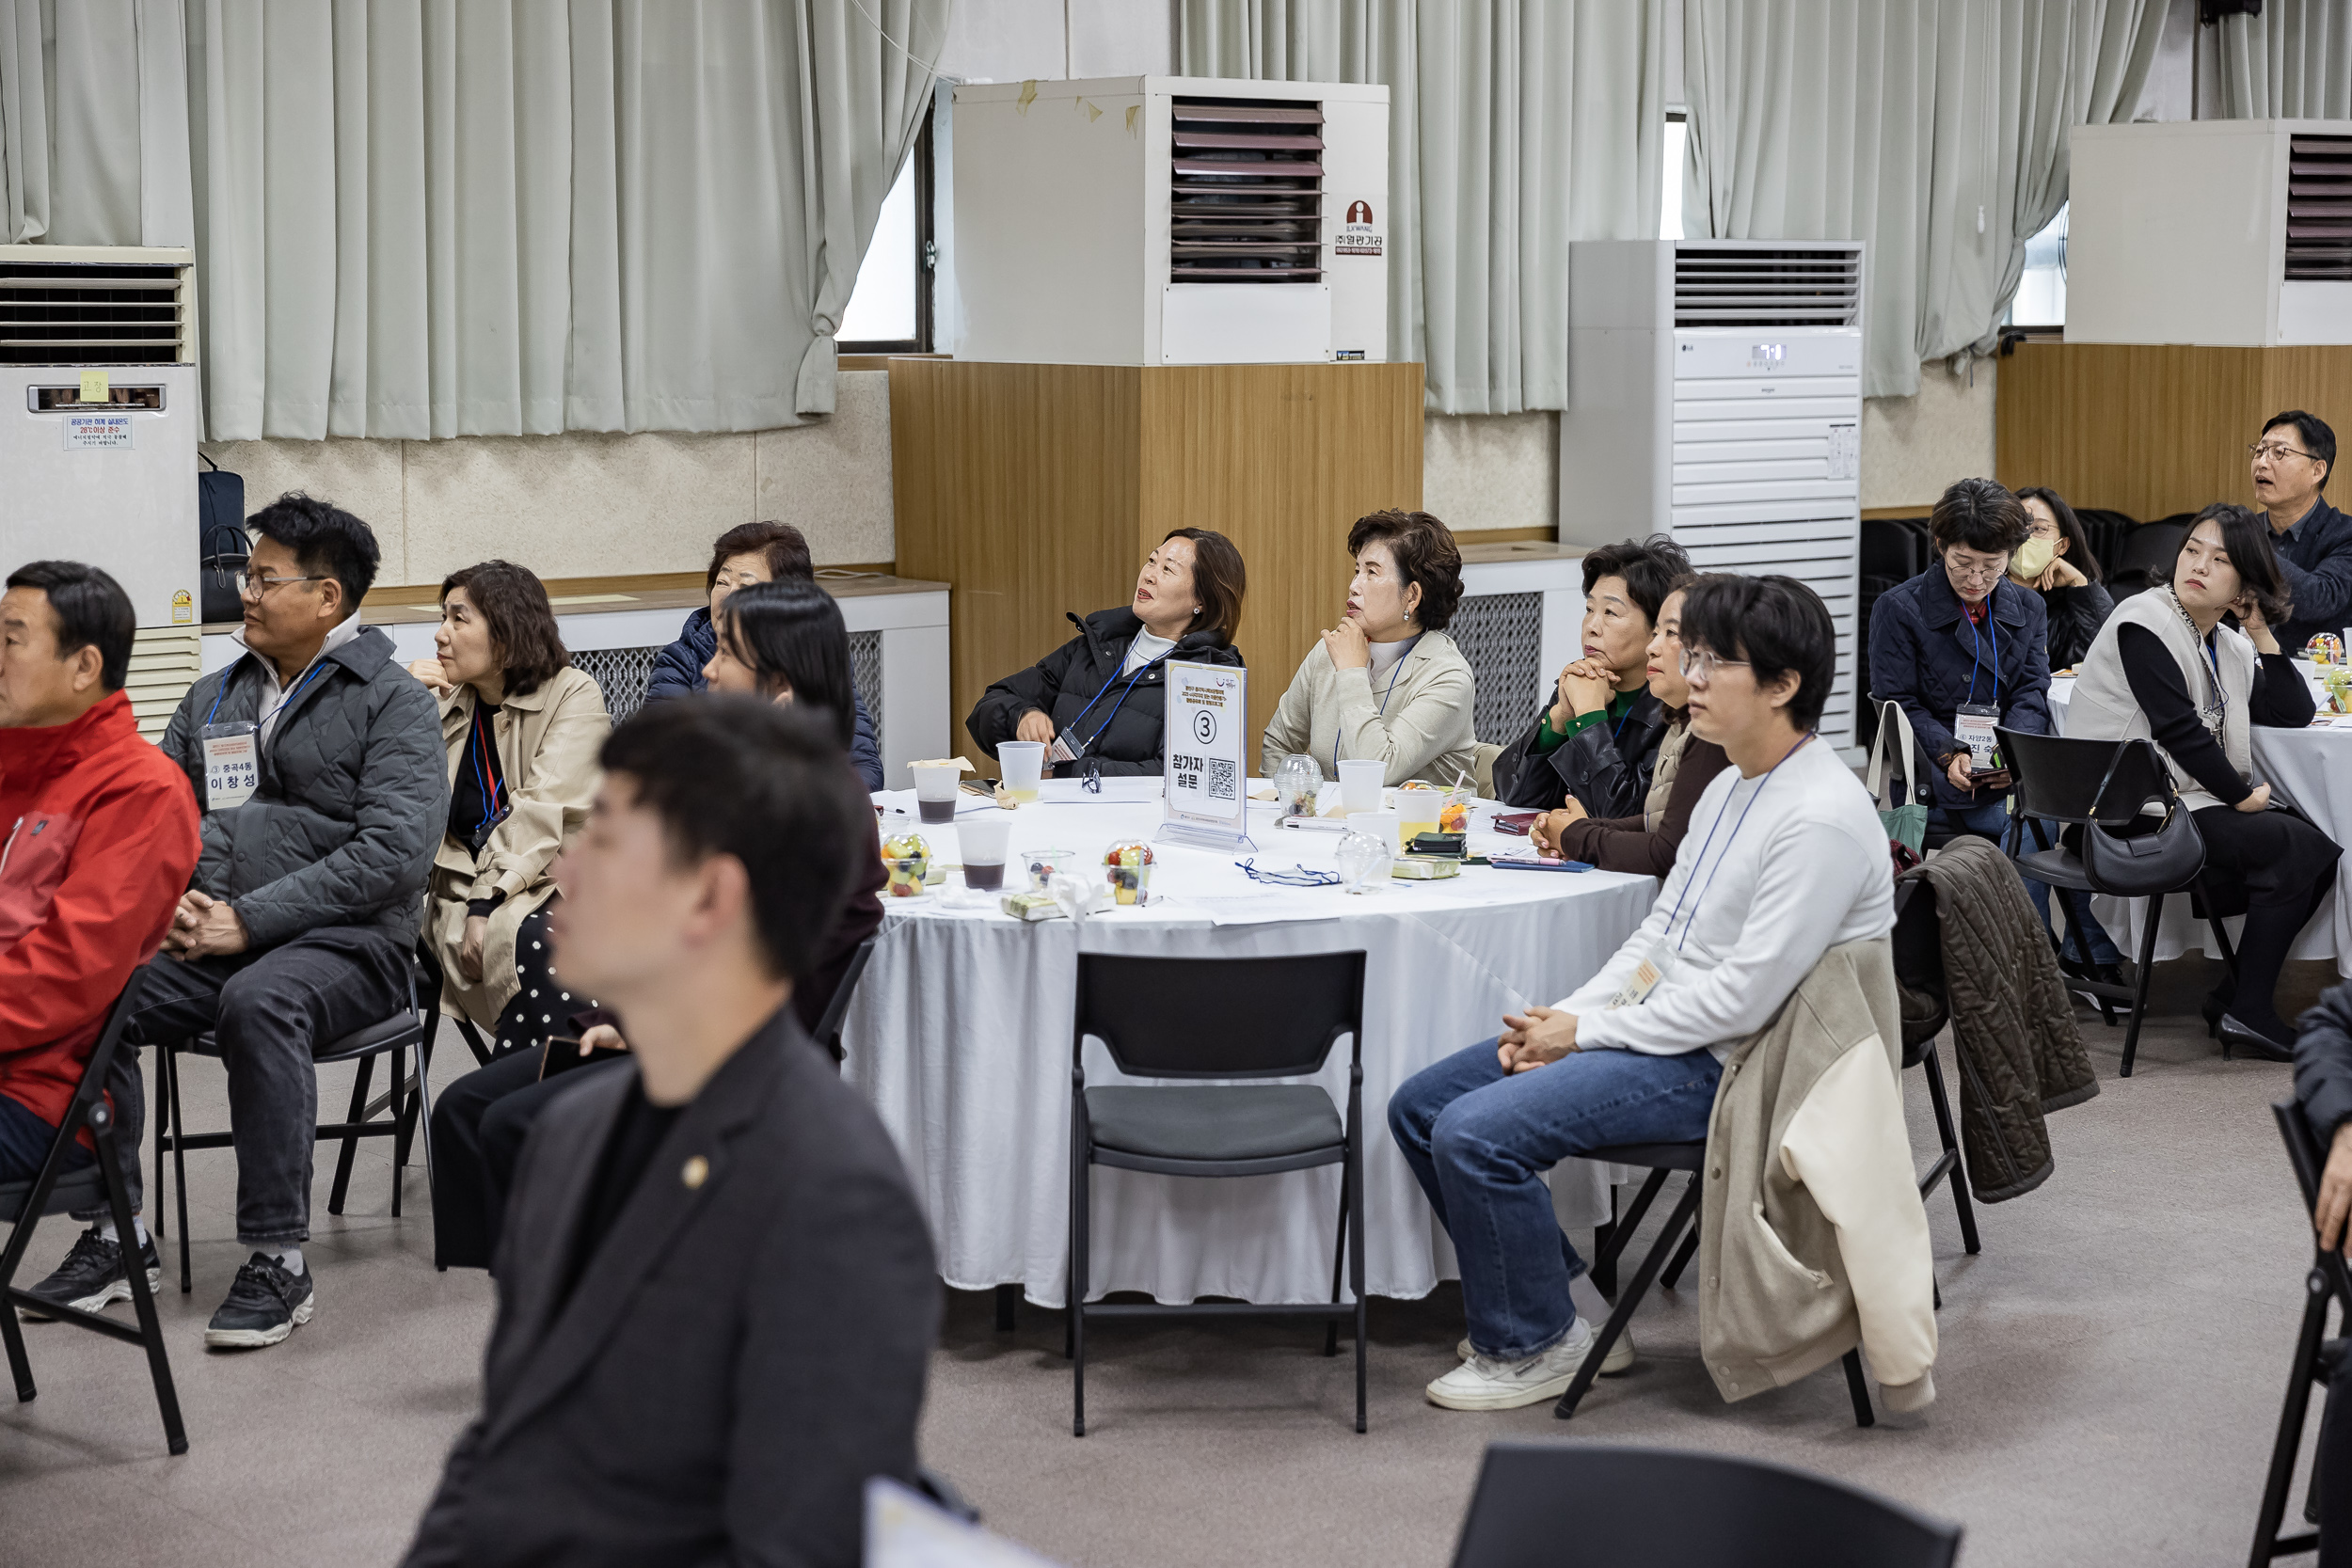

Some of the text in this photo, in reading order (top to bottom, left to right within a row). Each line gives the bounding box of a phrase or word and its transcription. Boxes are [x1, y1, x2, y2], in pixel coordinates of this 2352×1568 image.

[83, 381, 102, 392] 고장
[1968, 735, 1992, 743] 자양2동
[223, 762, 252, 772] 중곡4동
[1173, 753, 1203, 772] 참가자
[1178, 772, 1198, 789] 설문
